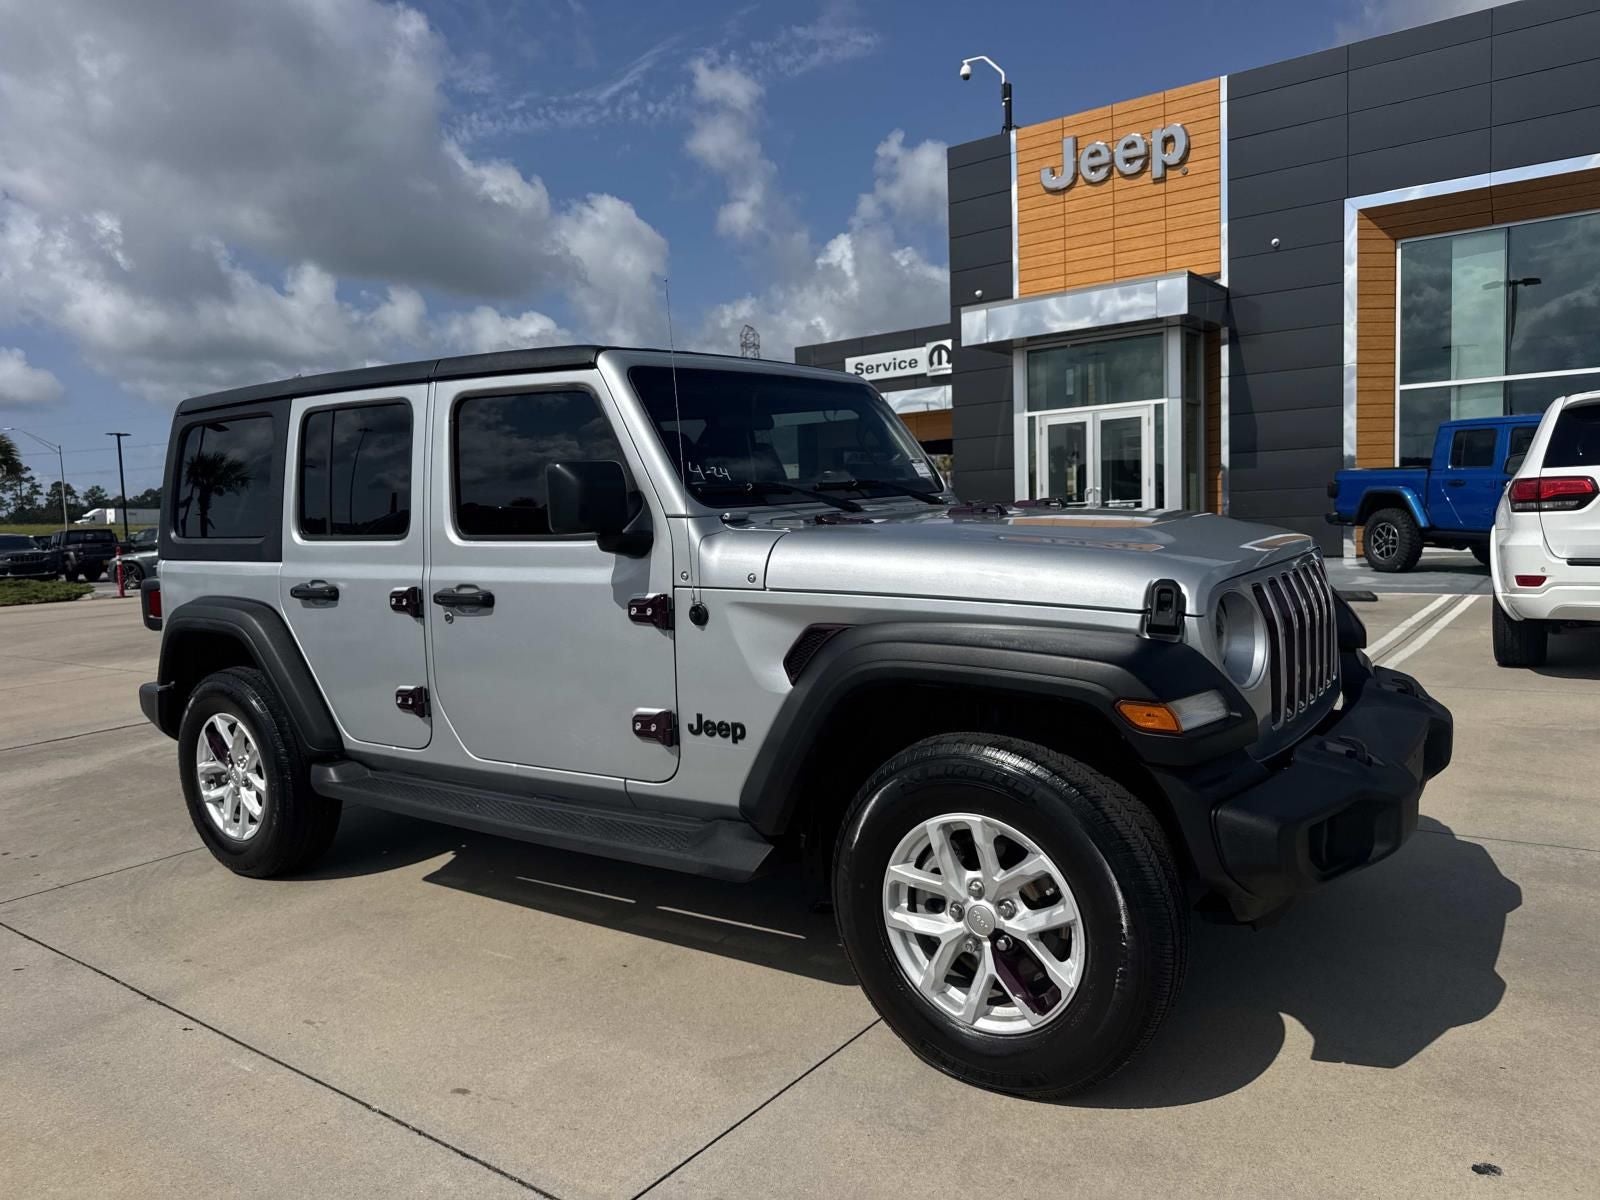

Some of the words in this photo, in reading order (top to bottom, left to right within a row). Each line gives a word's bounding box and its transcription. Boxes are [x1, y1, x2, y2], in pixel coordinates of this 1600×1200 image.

[1040, 123, 1190, 192] Jeep
[854, 357, 919, 376] Service
[688, 461, 732, 481] 4-24
[687, 712, 746, 745] Jeep
